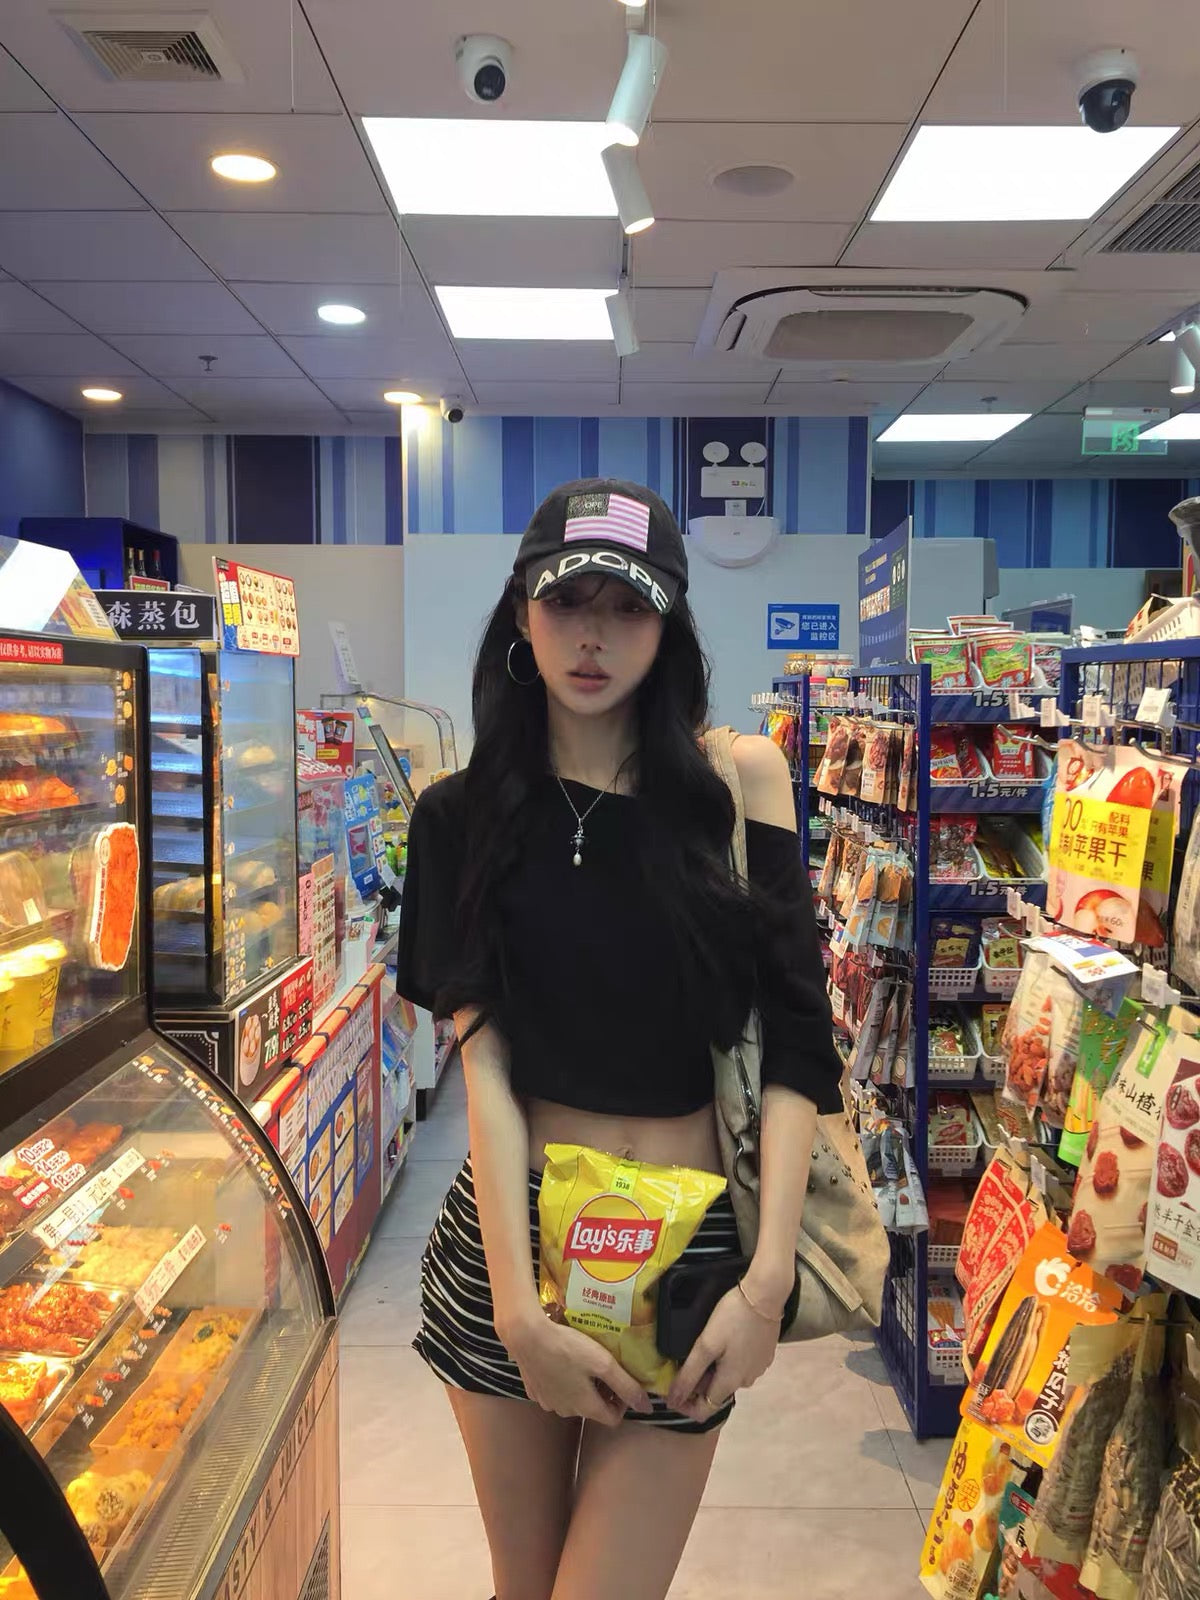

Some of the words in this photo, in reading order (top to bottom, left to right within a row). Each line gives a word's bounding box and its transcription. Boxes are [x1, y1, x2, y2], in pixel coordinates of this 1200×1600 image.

[801, 621, 837, 631] 您已进入
[810, 632, 837, 641] 监控区
[1109, 811, 1131, 827] 配料
[581, 1286, 617, 1305] 经典原味
[1059, 1280, 1101, 1312] 洽洽
